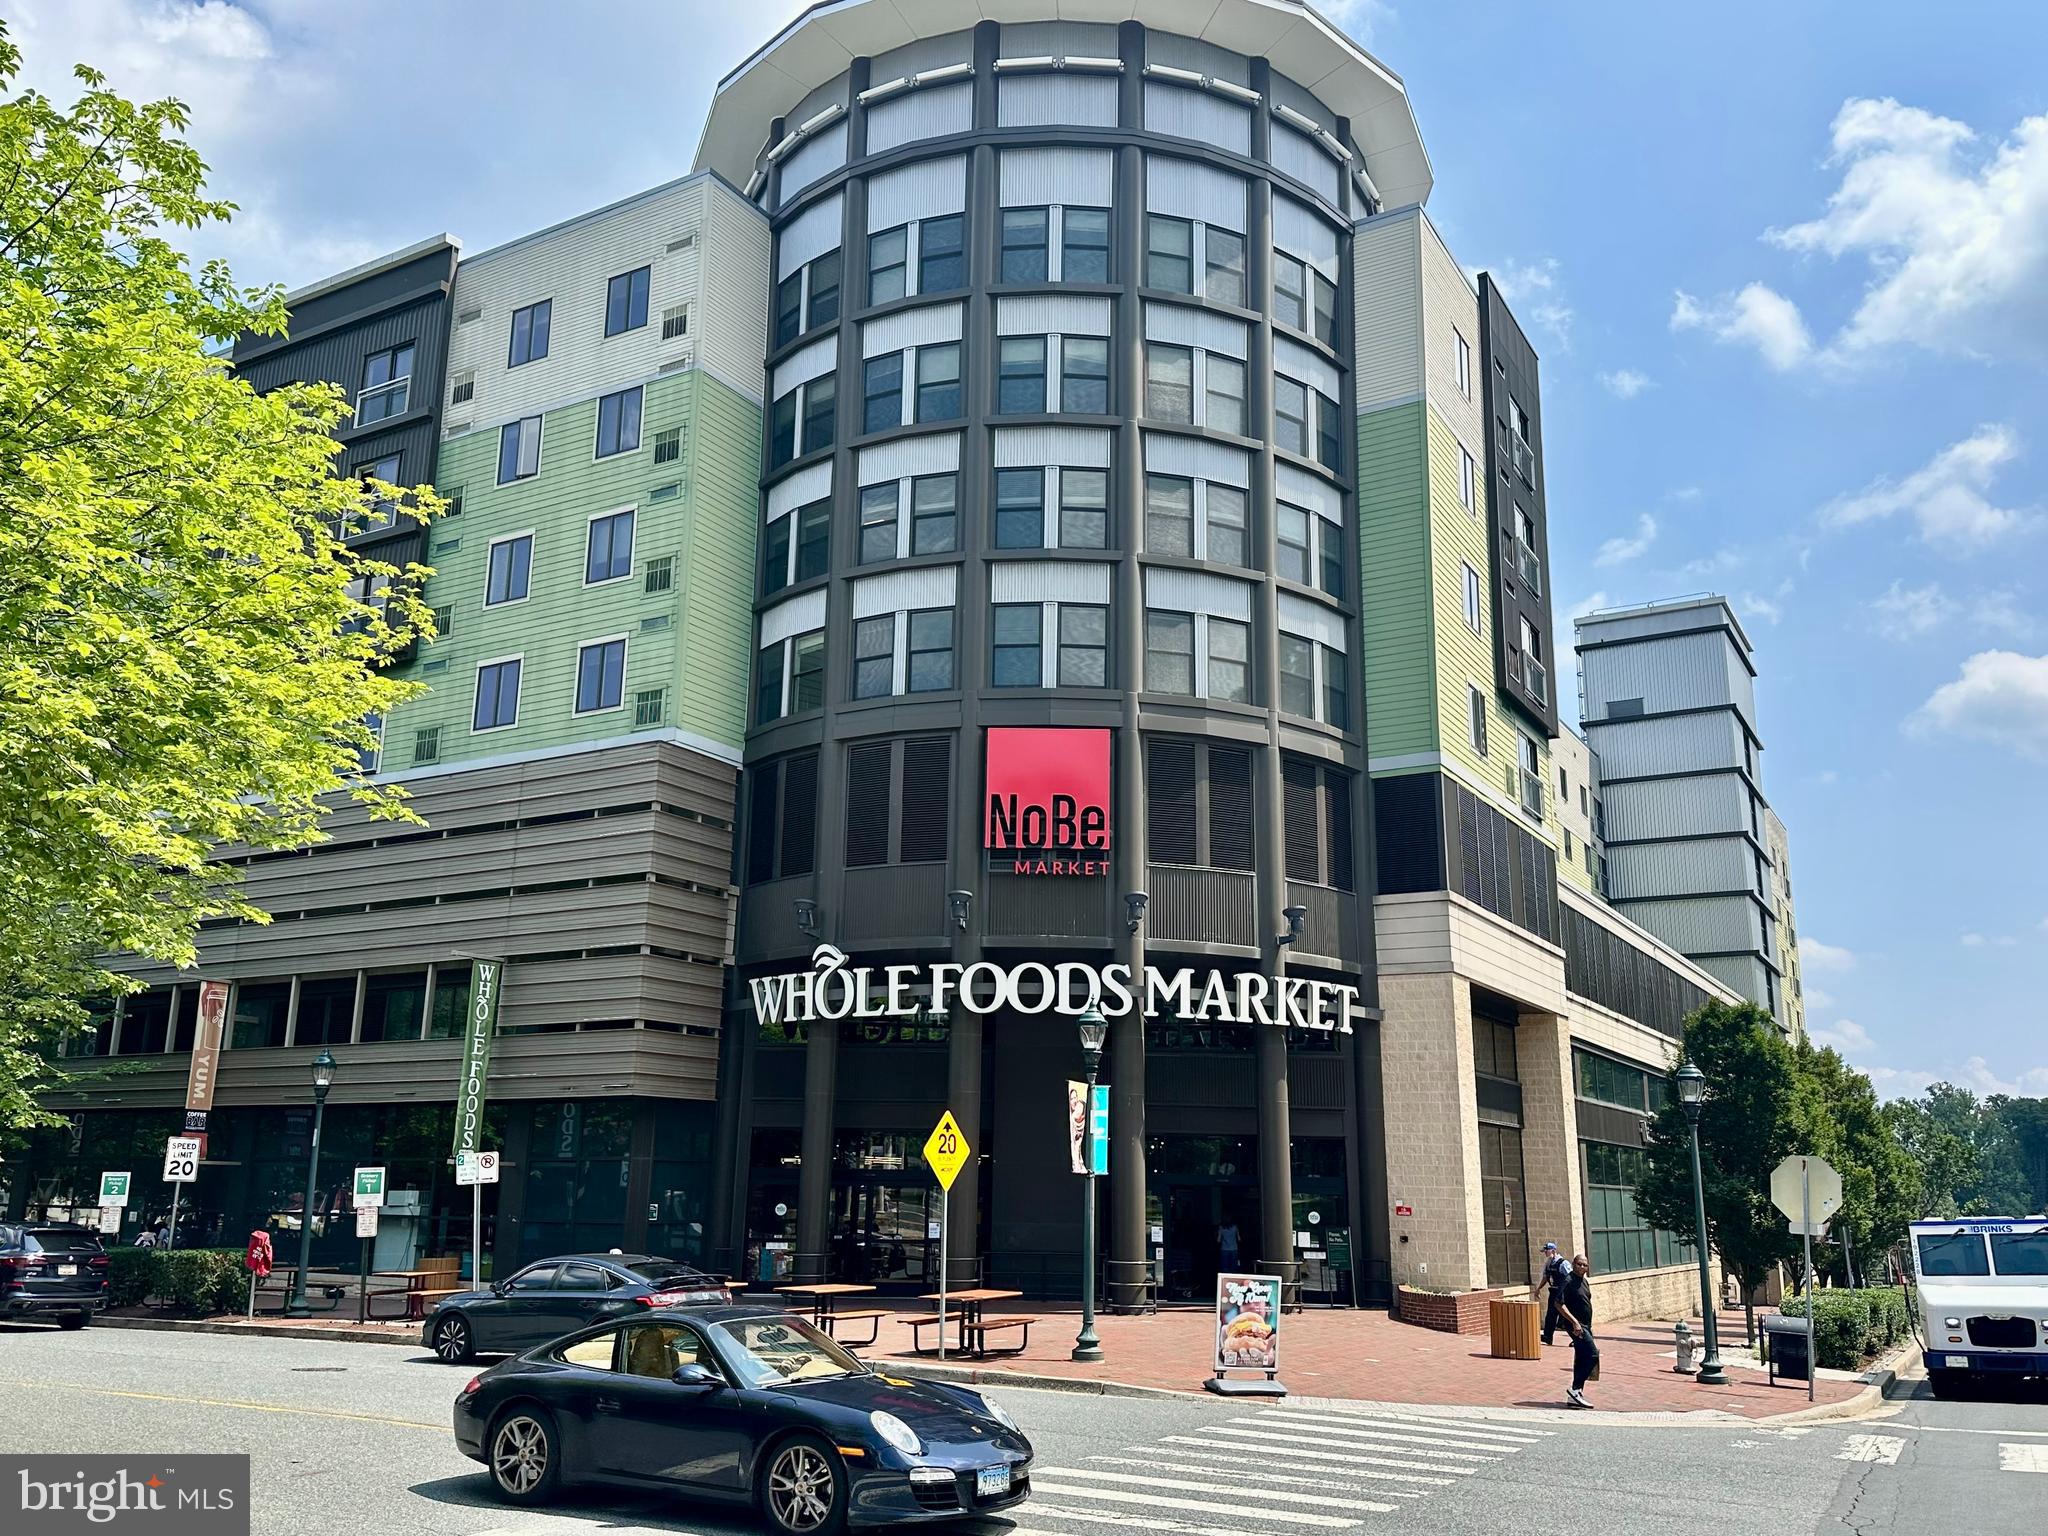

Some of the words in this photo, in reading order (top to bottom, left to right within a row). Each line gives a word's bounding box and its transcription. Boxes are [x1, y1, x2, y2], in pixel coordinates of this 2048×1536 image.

[990, 792, 1105, 850] NoBe
[1014, 860, 1110, 876] MARKET
[928, 961, 1134, 1017] FOODS
[1143, 966, 1360, 1035] MARKET
[461, 1061, 483, 1149] FOODS
[172, 1142, 197, 1150] SPEED
[938, 1133, 957, 1154] 20
[168, 1160, 194, 1176] 20
[110, 1185, 119, 1195] 2
[365, 1183, 371, 1193] 1
[1973, 1225, 2013, 1233] BRINKS
